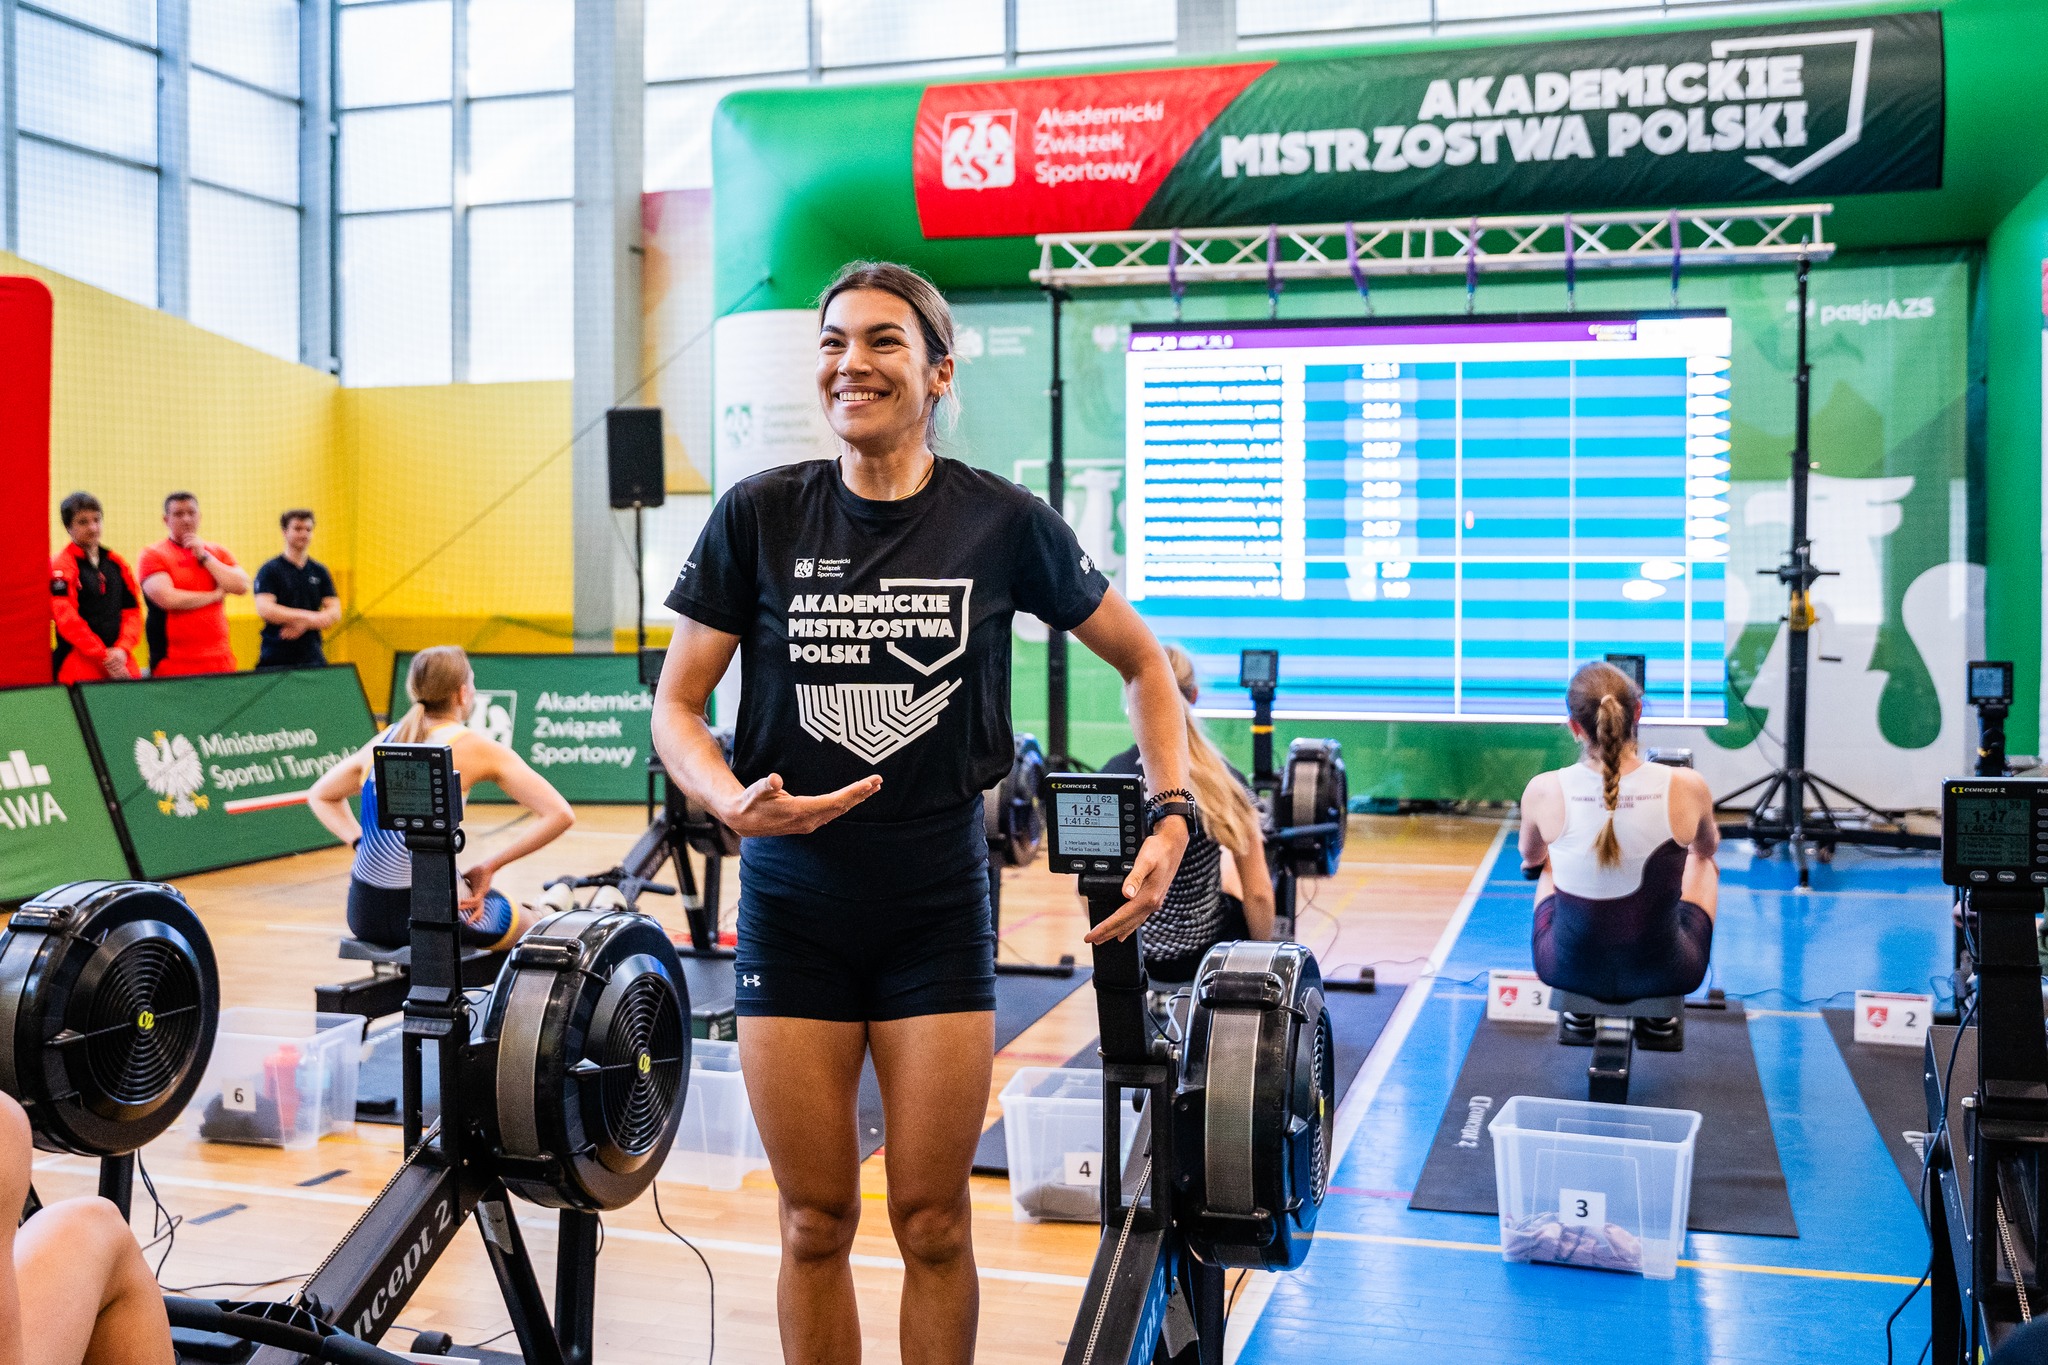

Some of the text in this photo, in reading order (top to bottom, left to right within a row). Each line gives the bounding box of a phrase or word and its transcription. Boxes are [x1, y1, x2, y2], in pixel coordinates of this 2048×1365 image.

[1417, 55, 1804, 121] AKADEMICKIE
[1036, 101, 1165, 128] Akademicki
[1034, 129, 1126, 157] Związek
[1220, 101, 1808, 179] MISTRZOSTWA POLSKI
[1035, 159, 1143, 188] Sportowy
[1820, 297, 1936, 327] pasjaAZS
[787, 594, 951, 613] AKADEMICKIE
[787, 618, 956, 640] MISTRZOSTWA
[788, 643, 871, 664] POLSKI
[532, 717, 623, 742] Związek
[197, 727, 318, 759] Ministerstwo
[530, 742, 637, 768] Sportowy
[208, 761, 276, 792] Sportu
[271, 757, 285, 781] i
[1071, 804, 1101, 816] 1:45
[1100, 796, 1112, 804] 62
[1064, 817, 1091, 825] 1:41.6
[1973, 810, 2008, 822] 1:47
[1531, 990, 1542, 1006] 3
[1904, 1011, 1917, 1027] 2
[234, 1087, 244, 1103] 6
[1079, 1160, 1092, 1178] 4
[1575, 1199, 1588, 1218] 3
[352, 1199, 451, 1340] ncept 2
